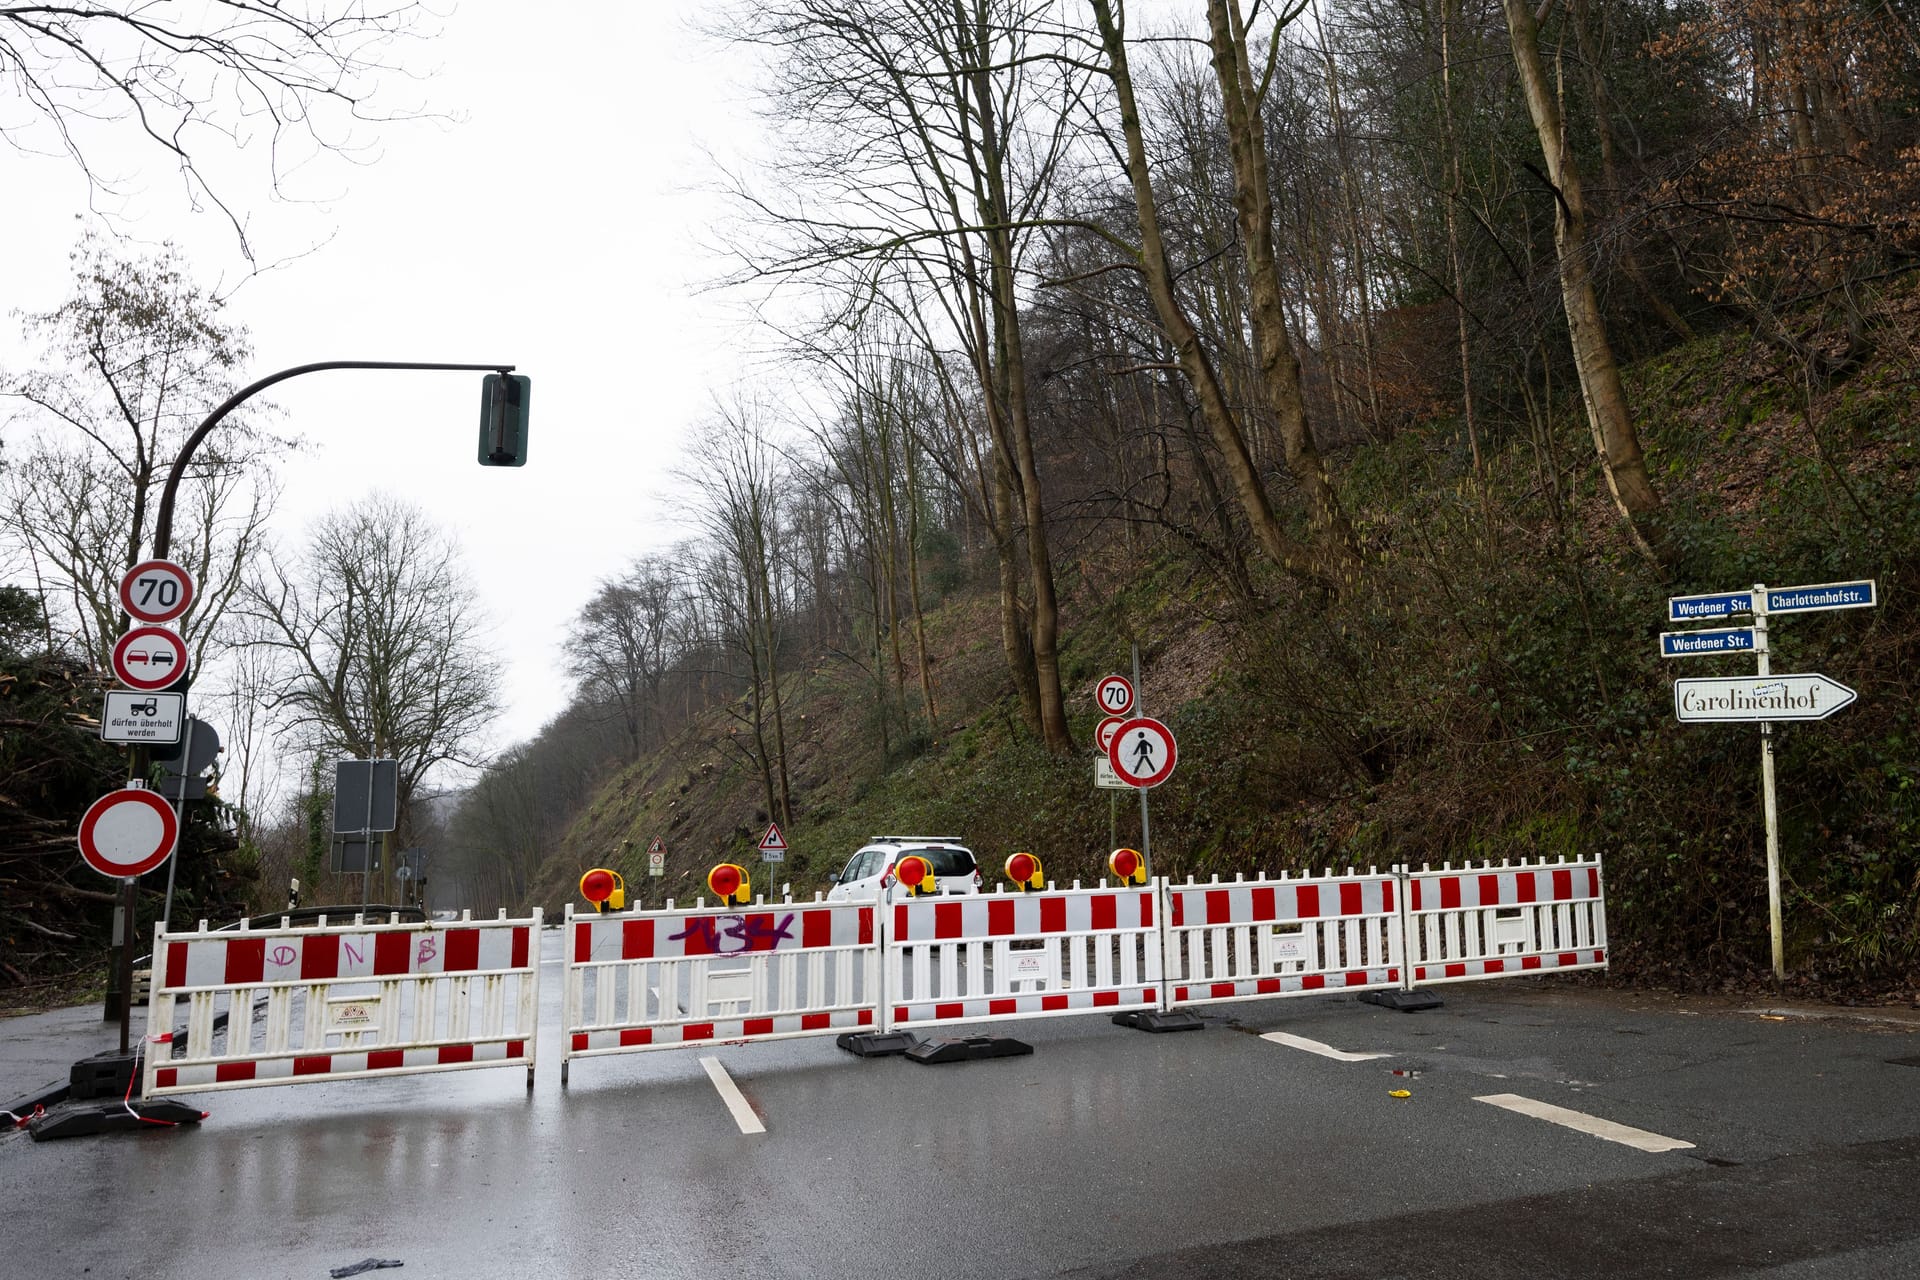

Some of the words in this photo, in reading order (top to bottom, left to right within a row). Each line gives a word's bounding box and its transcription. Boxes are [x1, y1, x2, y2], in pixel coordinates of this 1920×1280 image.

[139, 578, 178, 607] 70
[1772, 590, 1863, 608] Charlottenhofstr.
[1678, 601, 1726, 615] Werdener
[1731, 599, 1751, 612] Str.
[1672, 638, 1724, 651] Werdener
[1727, 635, 1749, 648] Str.
[1106, 687, 1126, 705] 70
[1683, 684, 1820, 712] Carolinenhof
[111, 718, 137, 728] dürfen
[140, 718, 172, 729] überholt
[127, 728, 156, 738] werden
